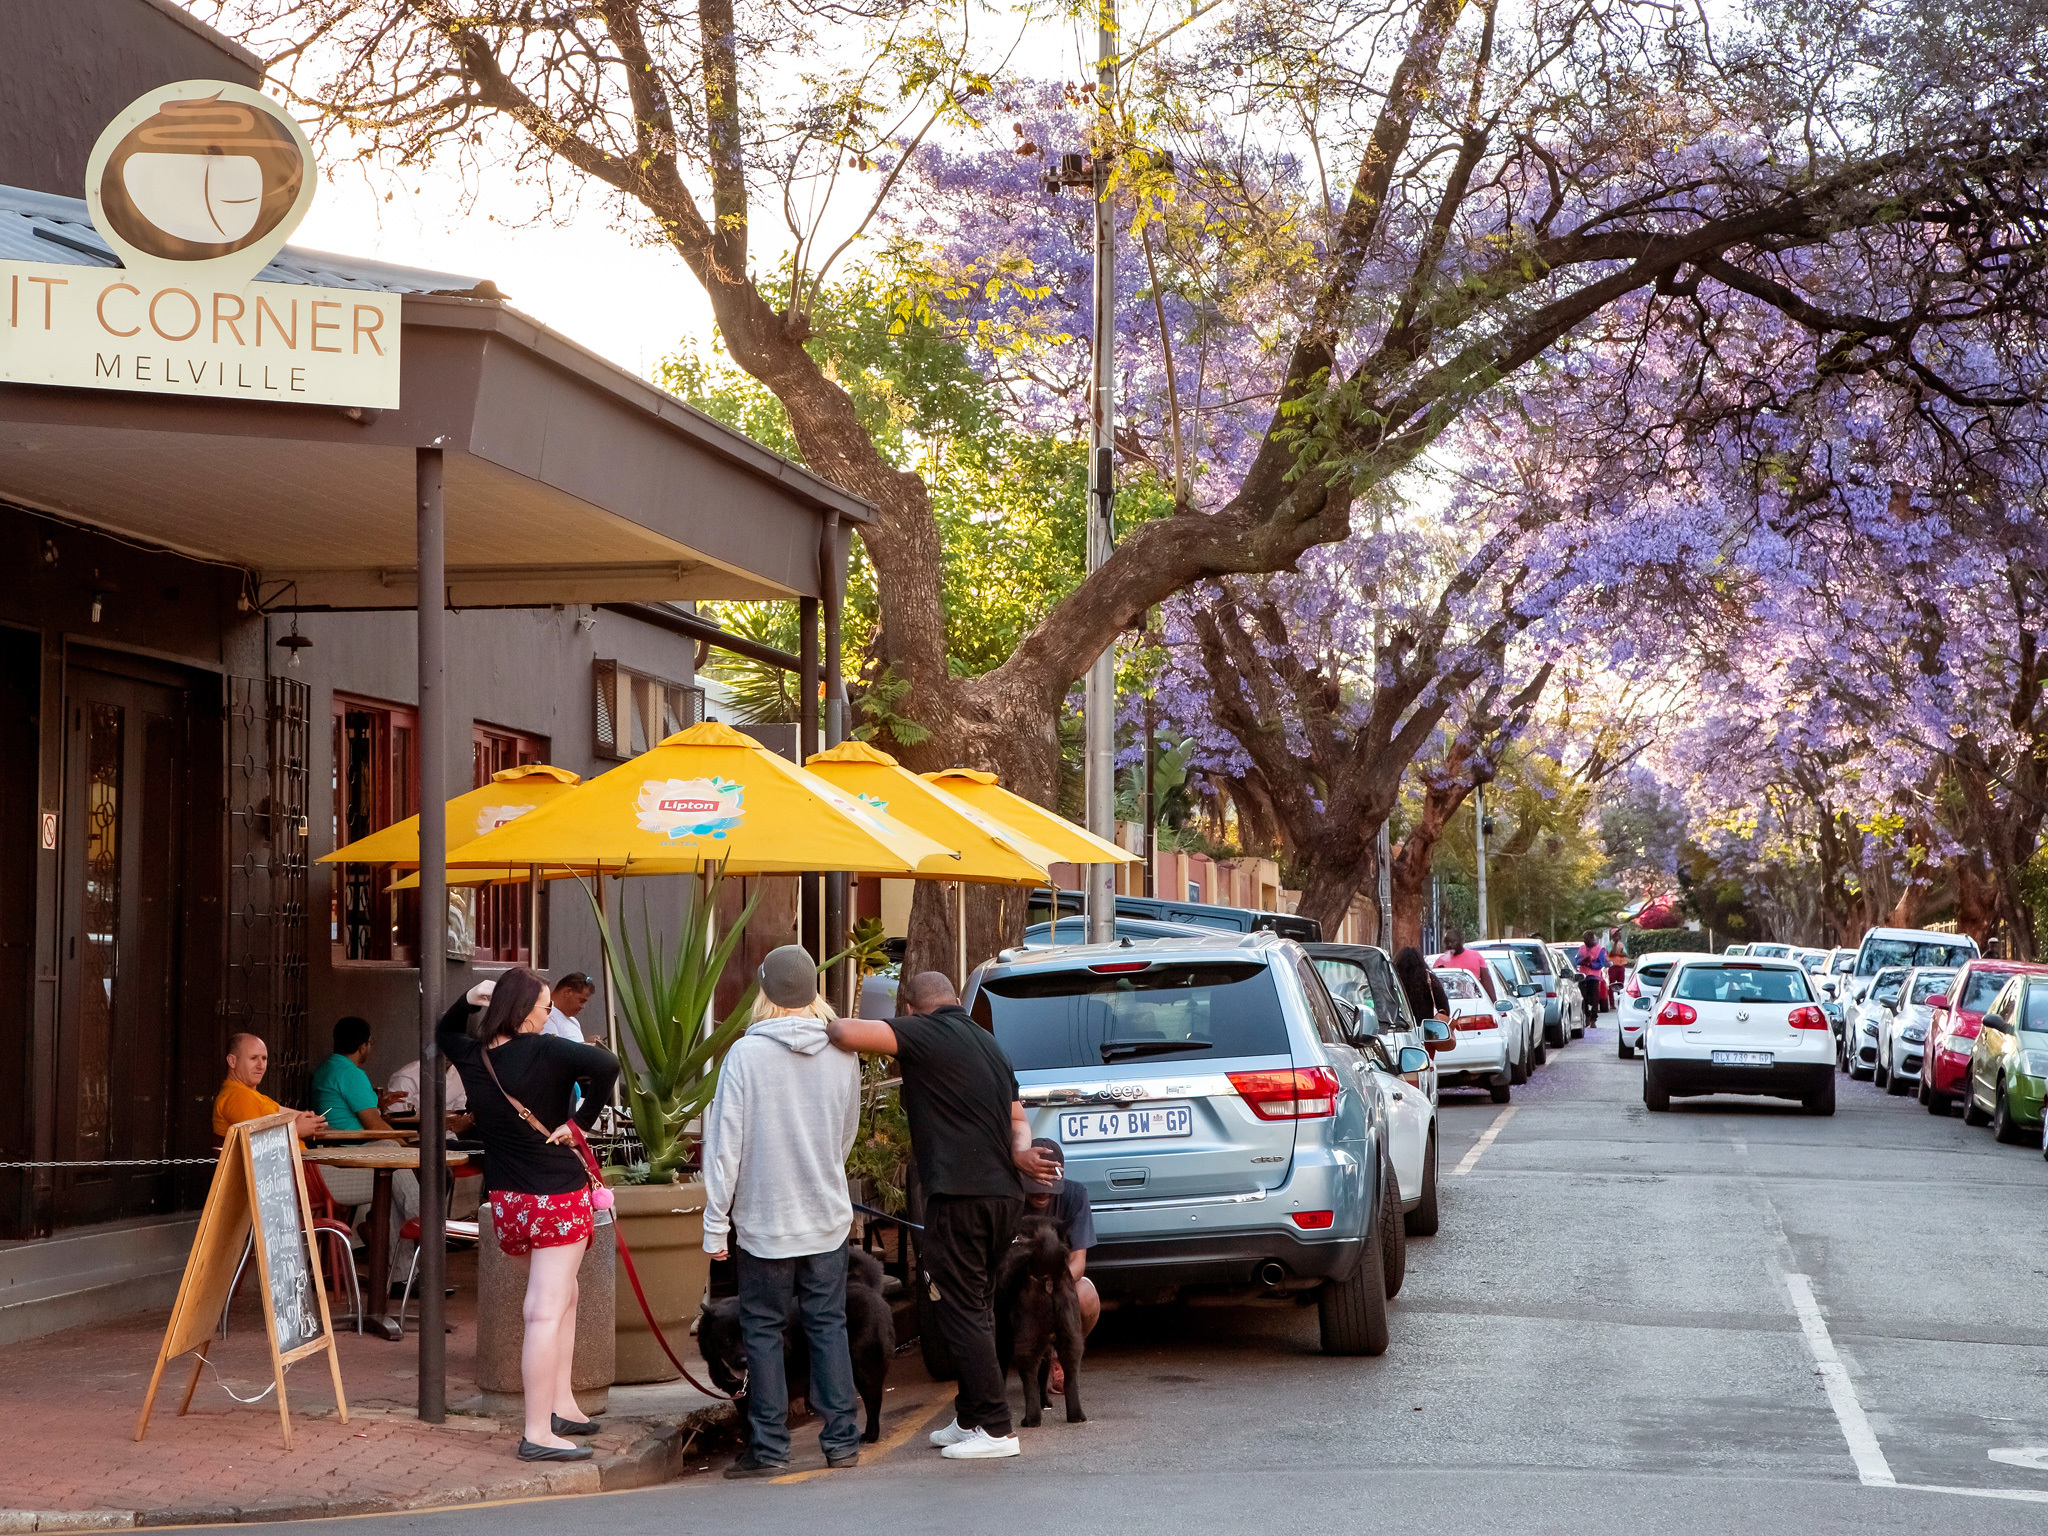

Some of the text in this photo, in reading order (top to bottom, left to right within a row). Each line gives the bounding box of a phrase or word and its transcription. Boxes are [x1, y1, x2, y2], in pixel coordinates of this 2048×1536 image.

[12, 275, 384, 356] IT CORNER
[96, 353, 305, 391] MELVILLE
[664, 801, 714, 811] Lipton
[1715, 1053, 1730, 1061] RLX
[1759, 1054, 1769, 1062] GP
[1099, 1084, 1144, 1099] Jeep
[1068, 1110, 1188, 1137] CF 49 BW GP
